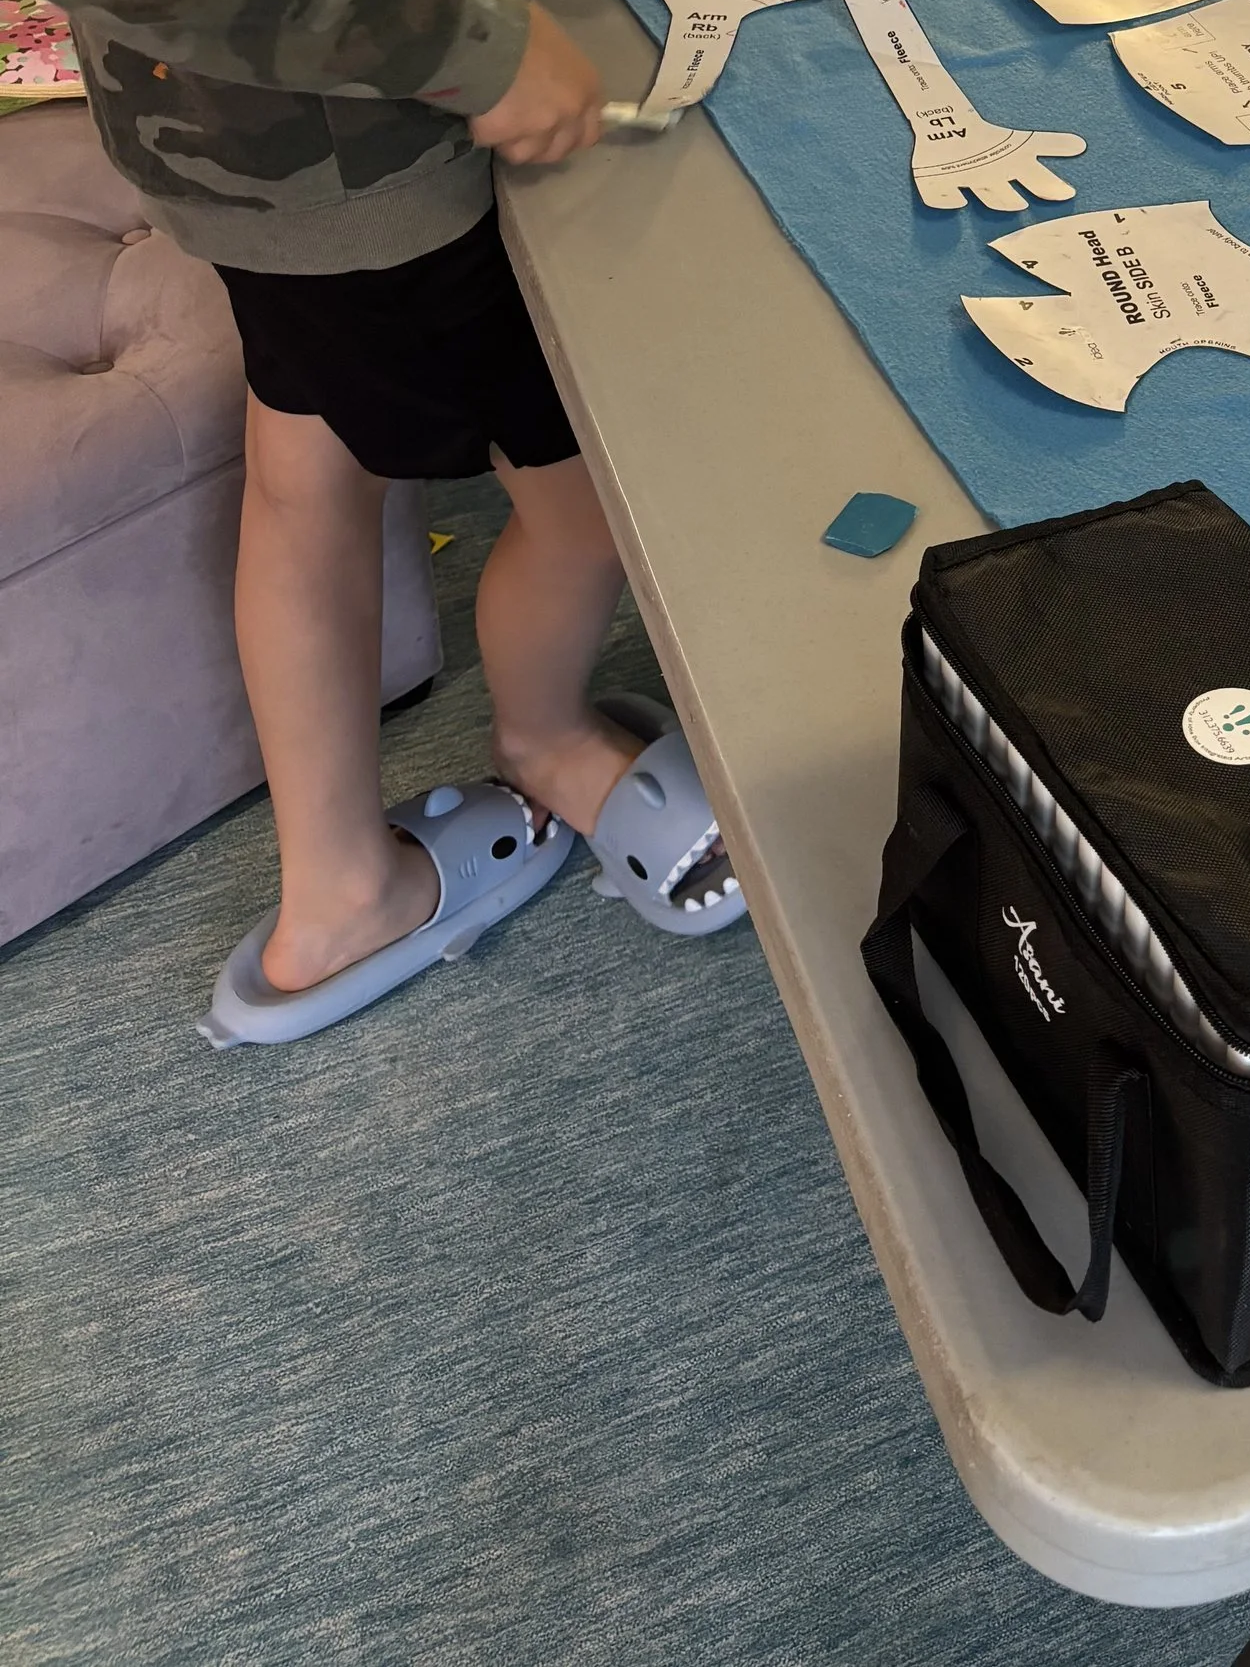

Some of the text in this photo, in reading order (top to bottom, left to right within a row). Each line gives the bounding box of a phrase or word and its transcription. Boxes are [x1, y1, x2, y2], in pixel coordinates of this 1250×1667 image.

[687, 12, 727, 21] Arm
[692, 24, 717, 32] Rb
[887, 31, 911, 64] Fleece
[687, 50, 704, 71] Fleece
[1205, 60, 1243, 94] Place arms
[1224, 62, 1250, 85] thumbs
[917, 76, 930, 91] Trace
[916, 106, 954, 118] (back)
[930, 116, 956, 128] Lb
[927, 128, 967, 141] Arm
[1113, 213, 1126, 223] 1
[1223, 236, 1241, 250] body
[1240, 247, 1250, 255] to
[1021, 260, 1039, 269] 4
[1078, 230, 1146, 325] ROUND Head
[1116, 246, 1171, 319] Skin SIDE B
[1193, 274, 1220, 309] Fleece
[1190, 297, 1206, 317] Trace
[1158, 339, 1237, 355] MOUTH OPENING
[1014, 357, 1034, 367] 2
